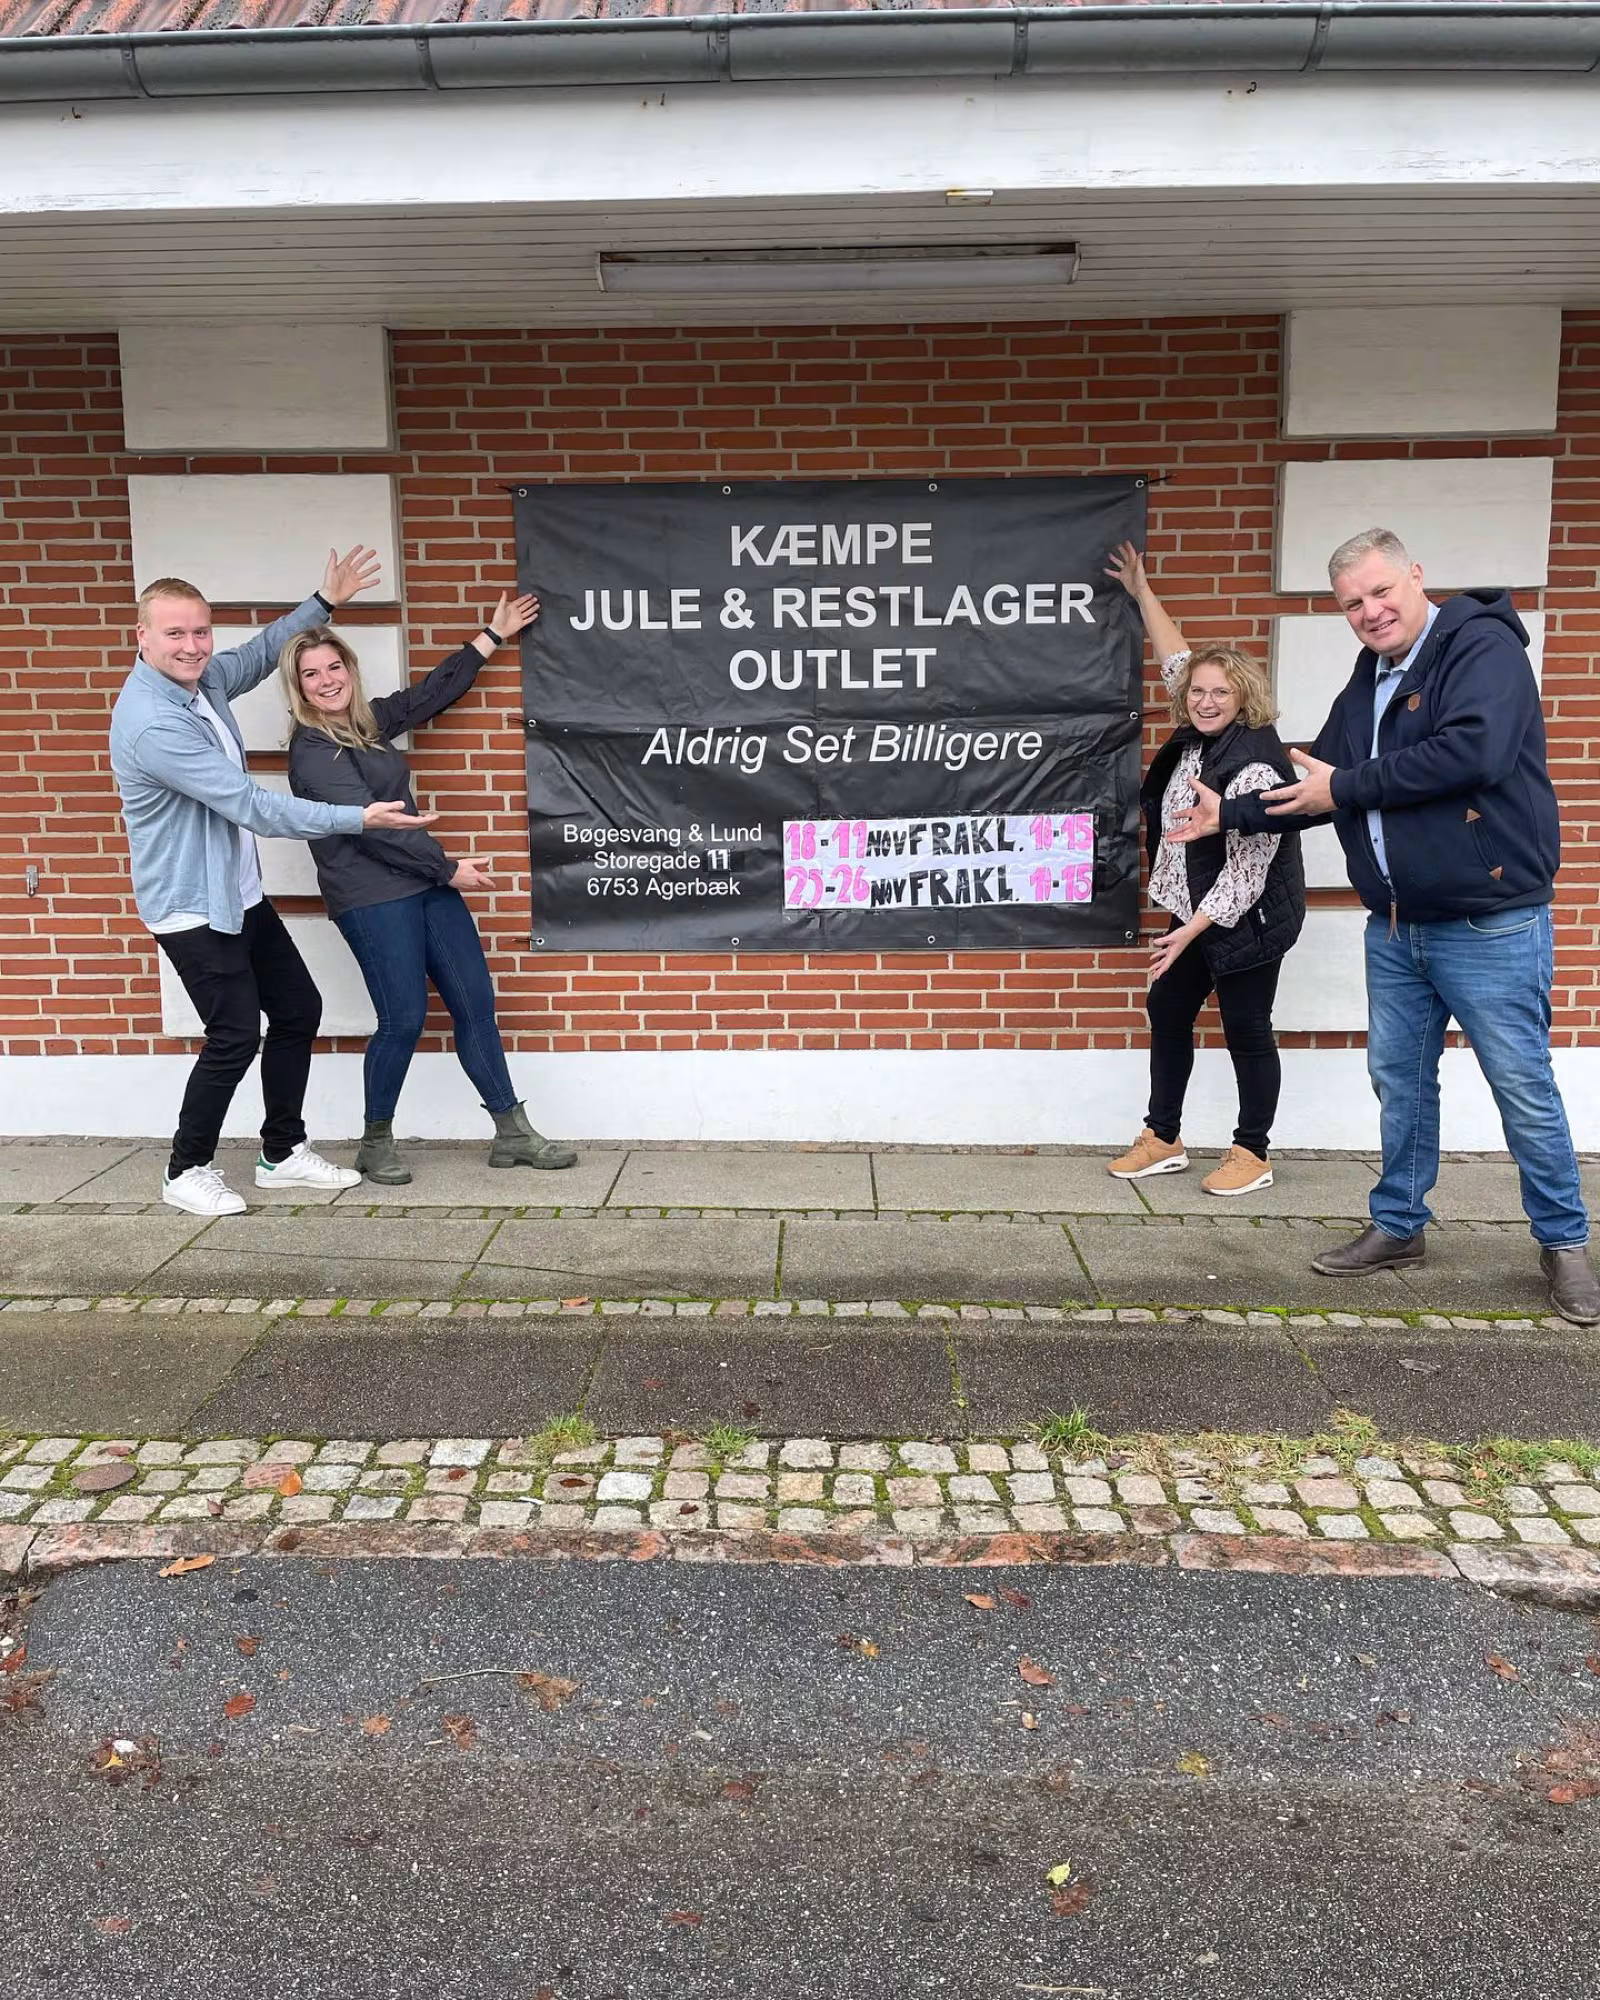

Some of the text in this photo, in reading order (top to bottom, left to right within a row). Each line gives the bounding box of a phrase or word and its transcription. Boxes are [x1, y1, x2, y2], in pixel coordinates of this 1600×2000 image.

[731, 522, 933, 566] KÆMPE
[569, 583, 1096, 631] JULE & RESTLAGER
[729, 648, 937, 691] OUTLET
[641, 723, 1042, 774] Aldrig Set Billigere
[563, 822, 762, 847] Bøgesvang & Lund
[594, 848, 730, 874] Storegade 11
[587, 876, 741, 900] 6753 Agerbæk
